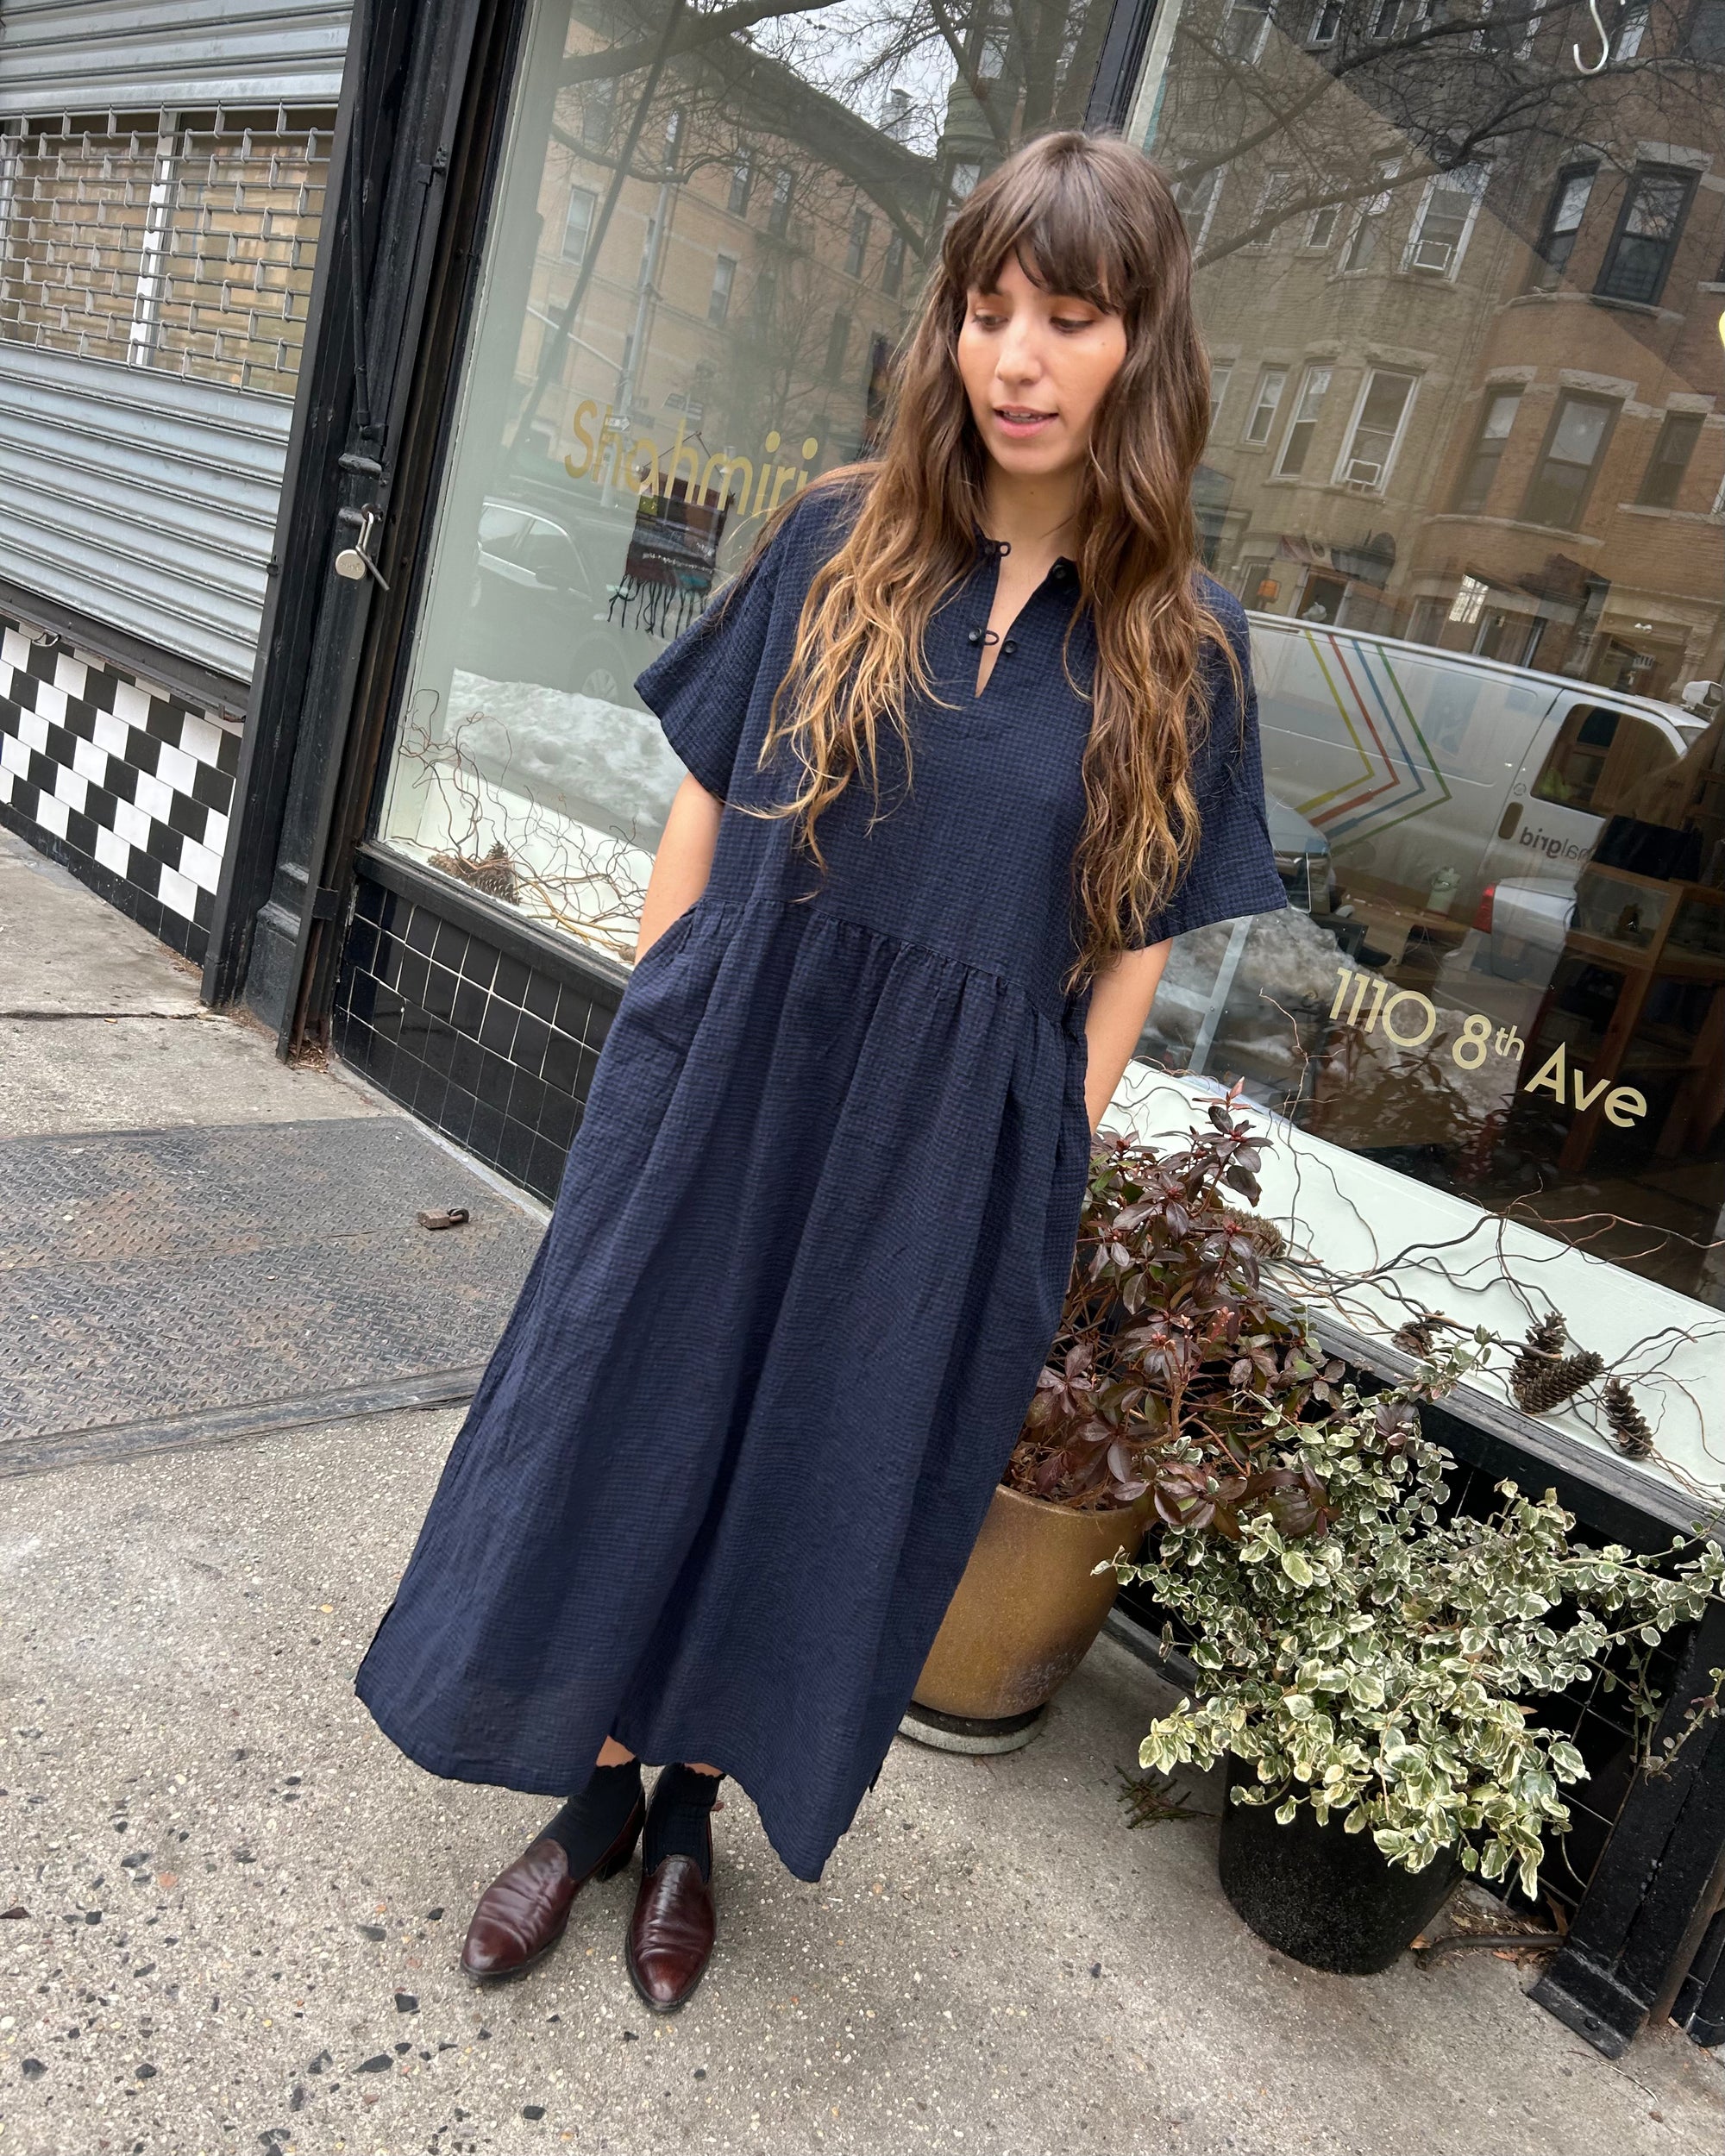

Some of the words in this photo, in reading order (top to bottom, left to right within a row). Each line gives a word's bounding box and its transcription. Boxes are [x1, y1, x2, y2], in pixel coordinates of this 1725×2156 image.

[1329, 968, 1437, 1047] 1110
[1452, 1014, 1525, 1070] 8th
[1524, 1041, 1647, 1127] Ave
